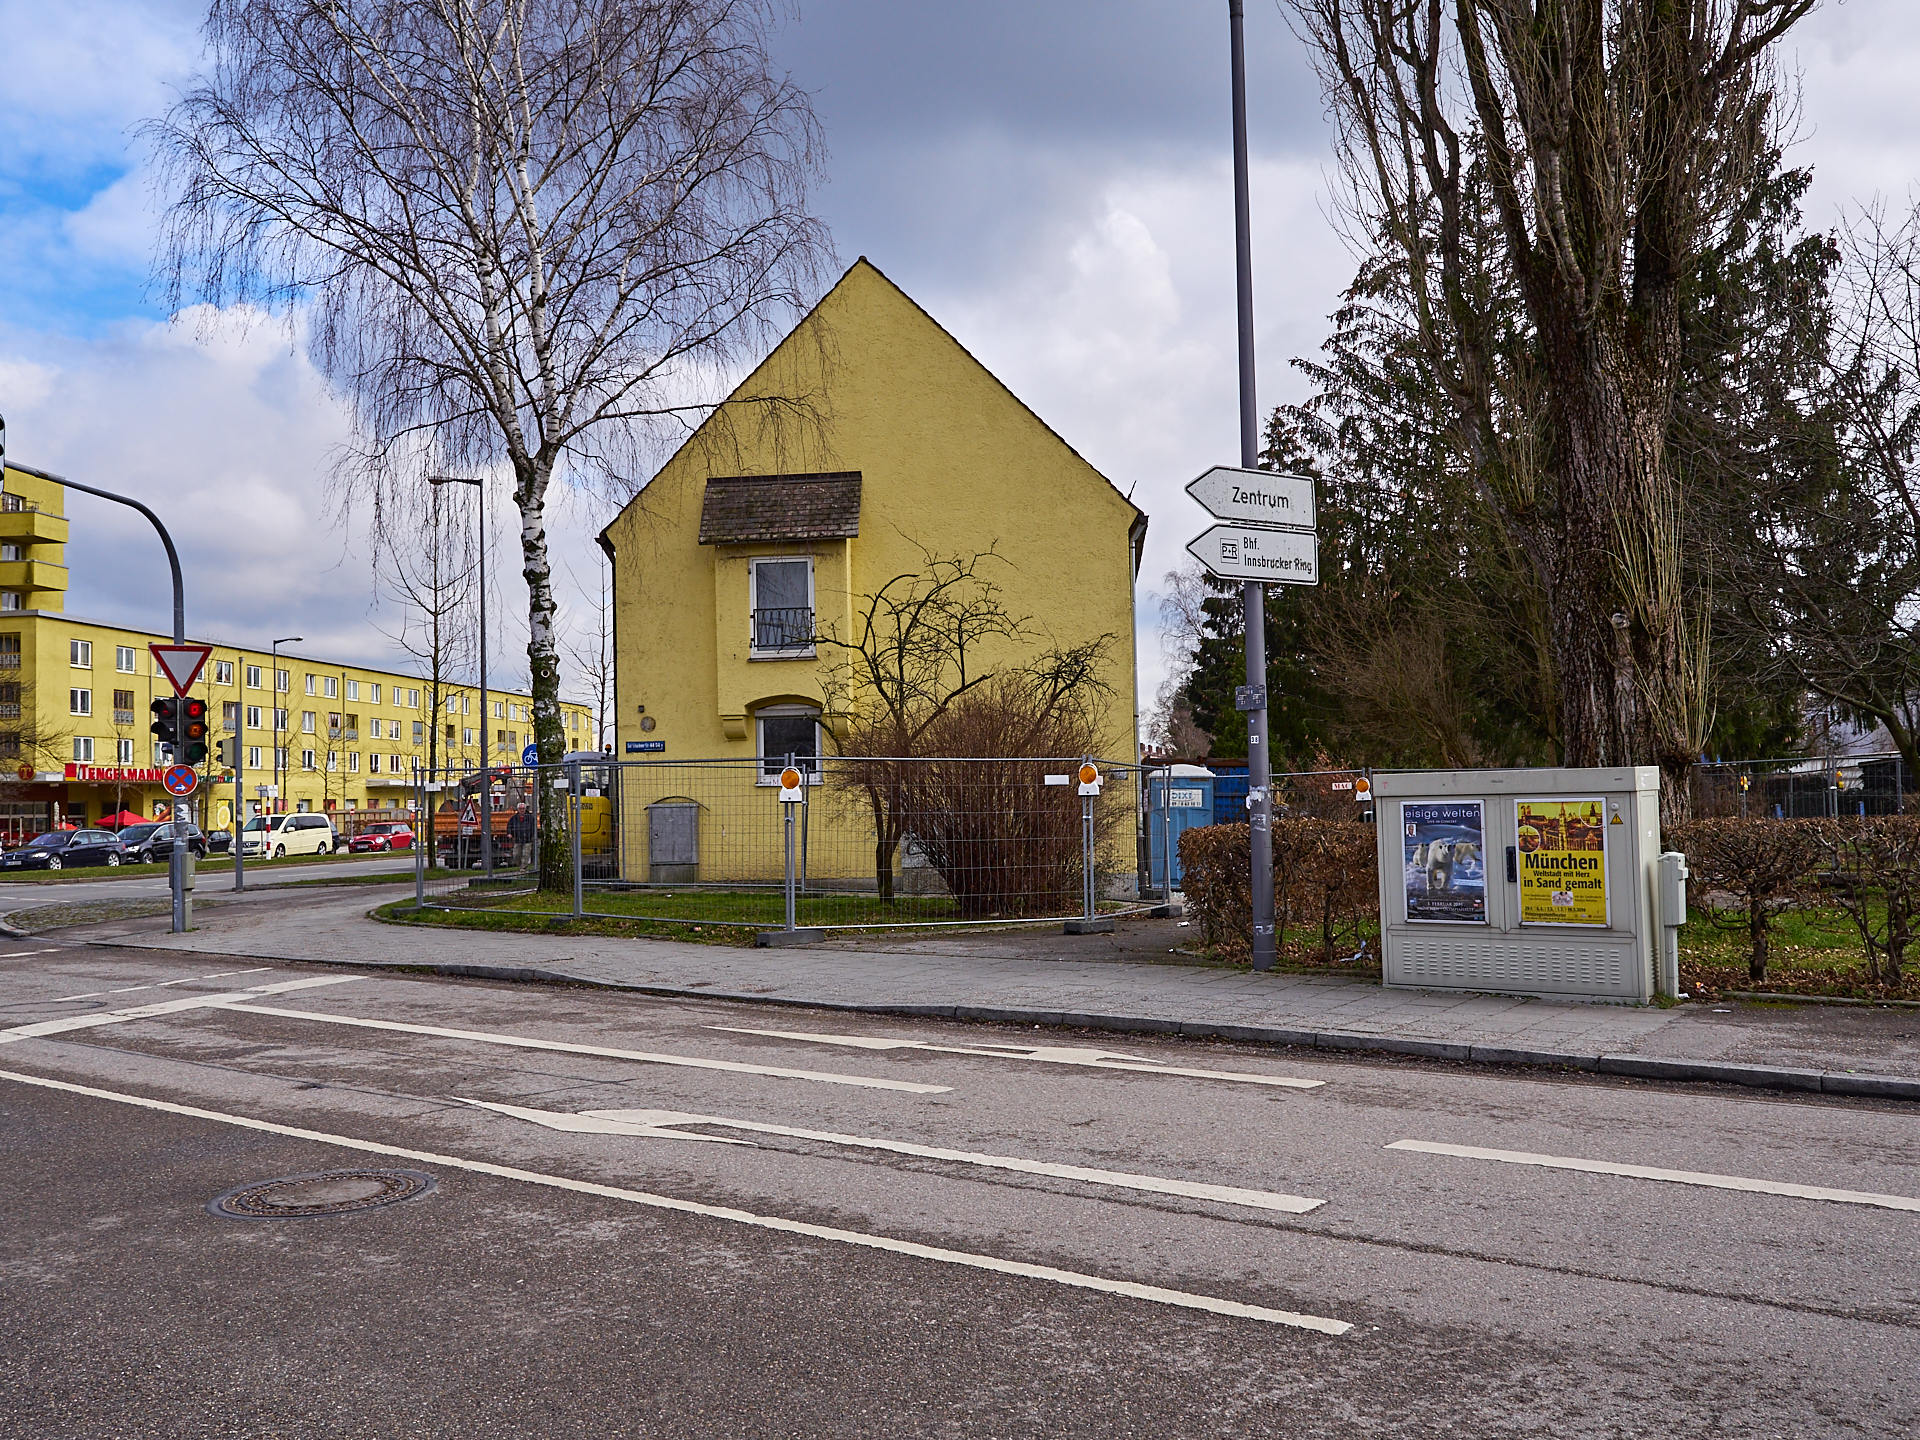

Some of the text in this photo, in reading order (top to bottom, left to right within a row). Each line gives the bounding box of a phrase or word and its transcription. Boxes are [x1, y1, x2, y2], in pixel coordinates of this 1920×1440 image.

[1232, 486, 1289, 508] Zentrum
[1243, 536, 1260, 550] Bhf.
[1244, 554, 1313, 574] Innsbrucker Ring
[20, 767, 32, 779] T
[79, 763, 162, 781] TENGELMANN
[1405, 809, 1480, 820] eisige welten
[1525, 853, 1598, 870] München
[1523, 877, 1602, 892] in Sand gemalt
